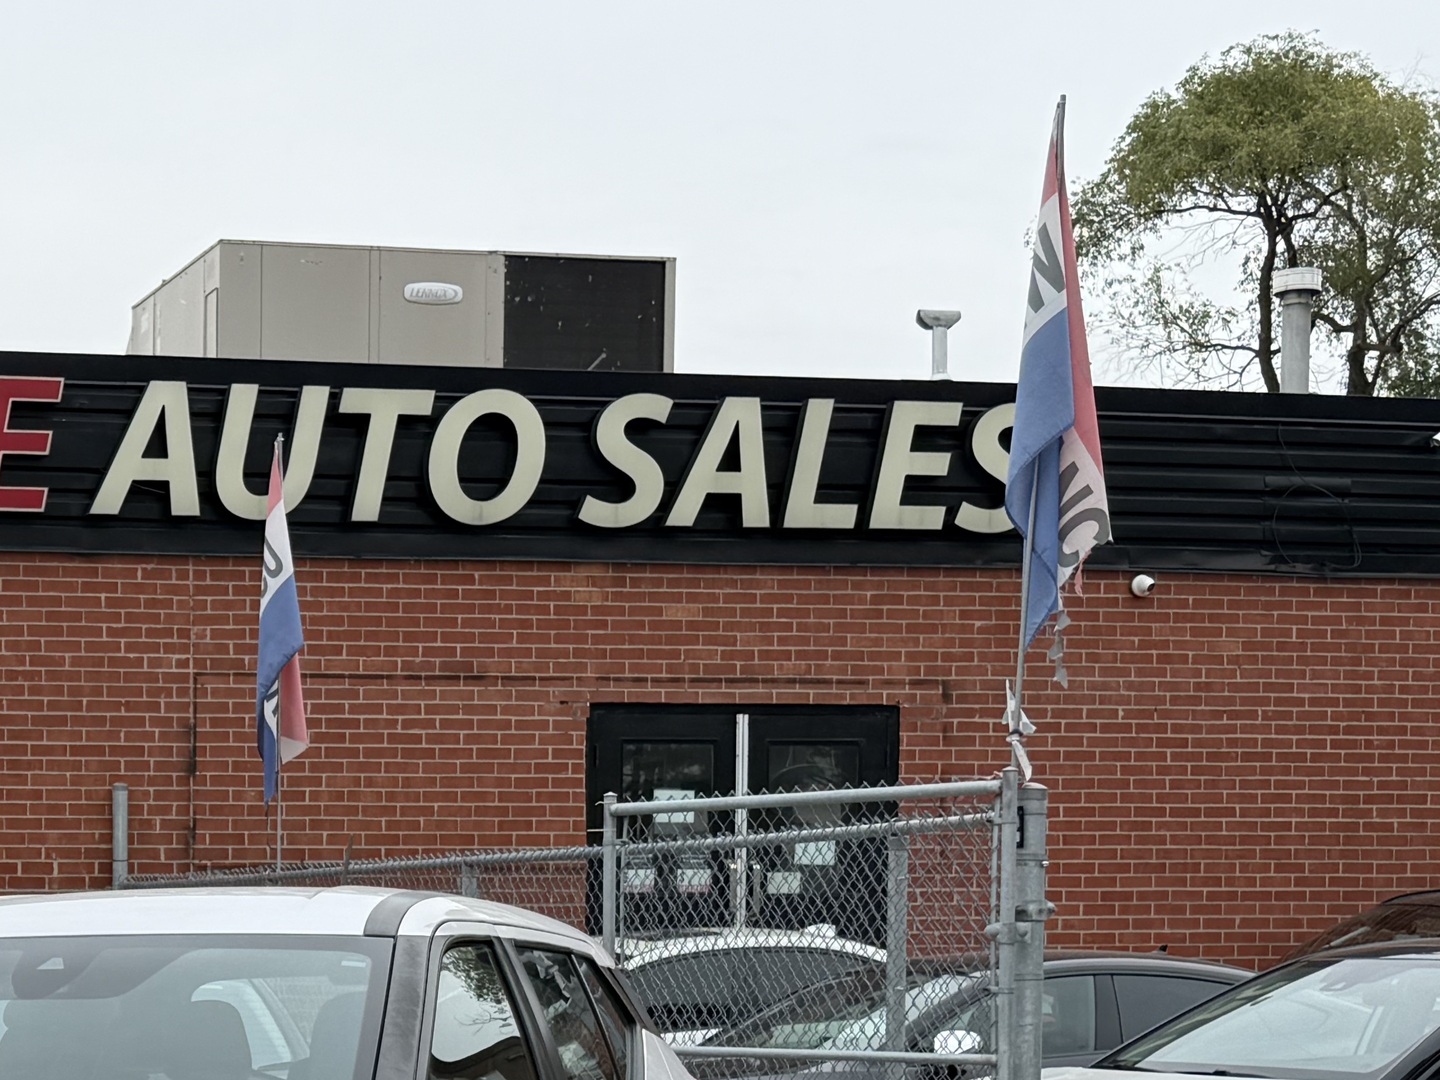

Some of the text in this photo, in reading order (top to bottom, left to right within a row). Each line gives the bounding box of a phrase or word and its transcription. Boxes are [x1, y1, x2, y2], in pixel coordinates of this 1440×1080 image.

[409, 287, 448, 299] LENNOX
[89, 380, 547, 527] AUTO
[577, 392, 1022, 534] SALES
